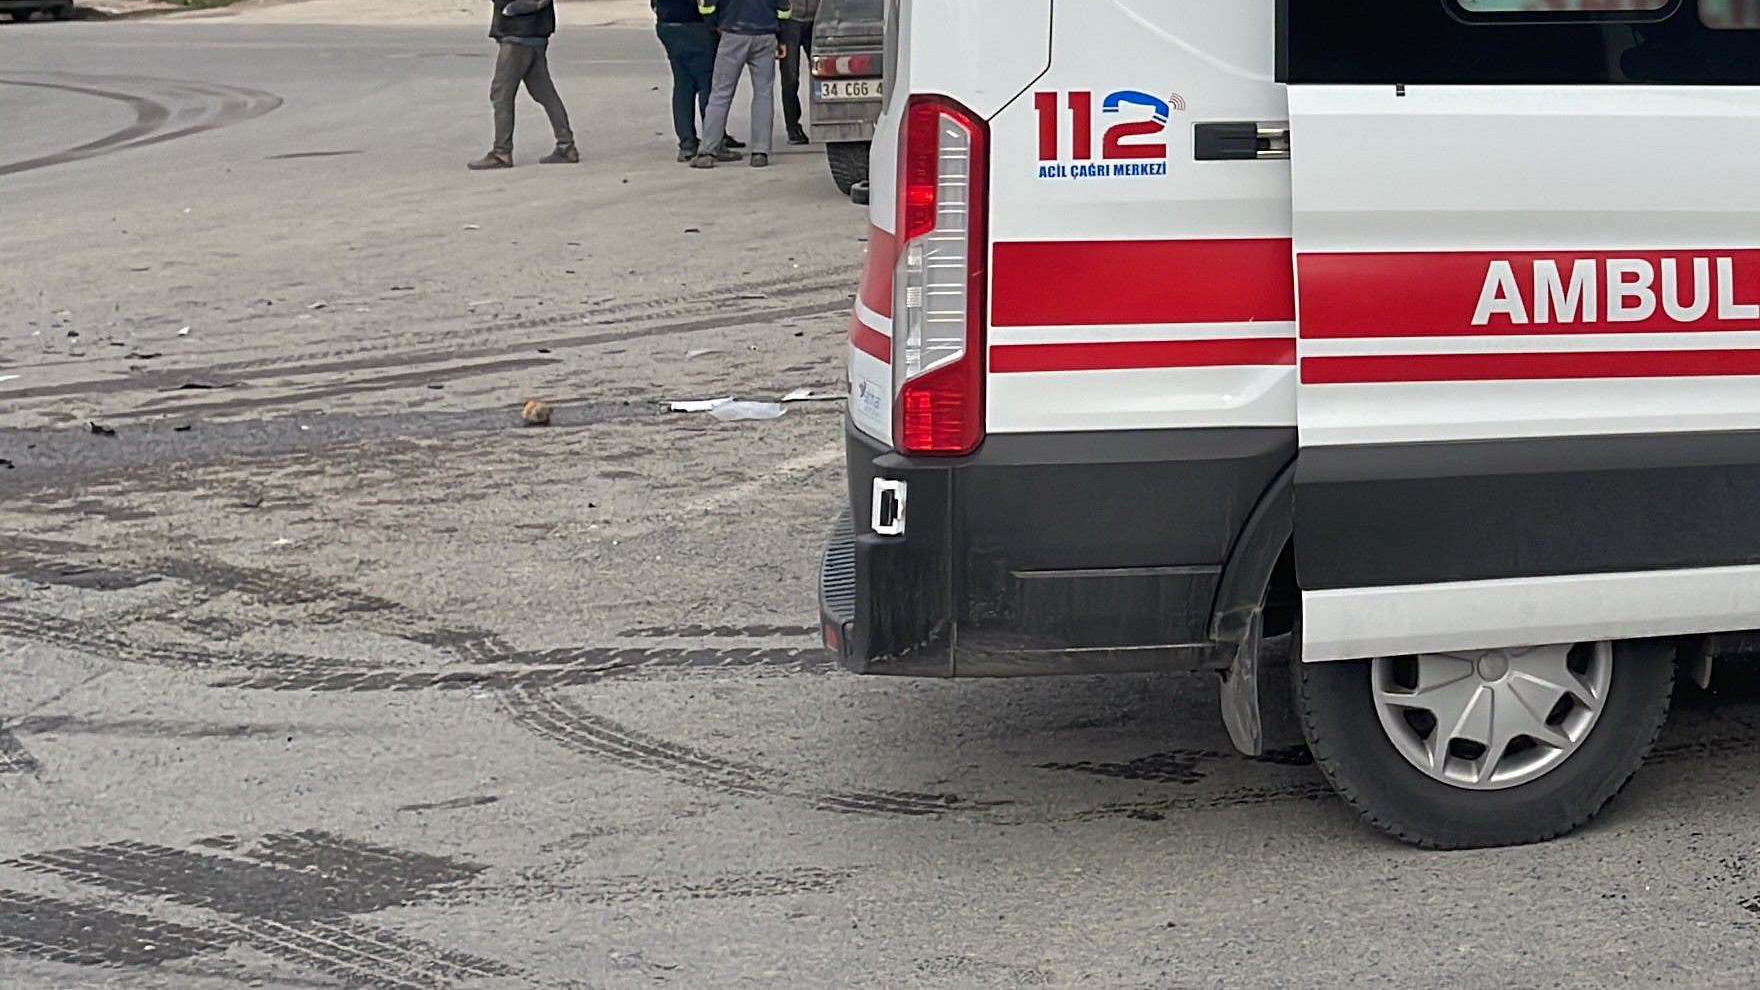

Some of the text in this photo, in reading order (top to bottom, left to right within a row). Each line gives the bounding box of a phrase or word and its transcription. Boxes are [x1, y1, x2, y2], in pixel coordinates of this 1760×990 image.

[822, 83, 838, 97] 34
[845, 82, 869, 96] CGG
[1034, 90, 1170, 161] 112
[1039, 161, 1167, 179] ACİL ÇAĞRI MERKEZİ
